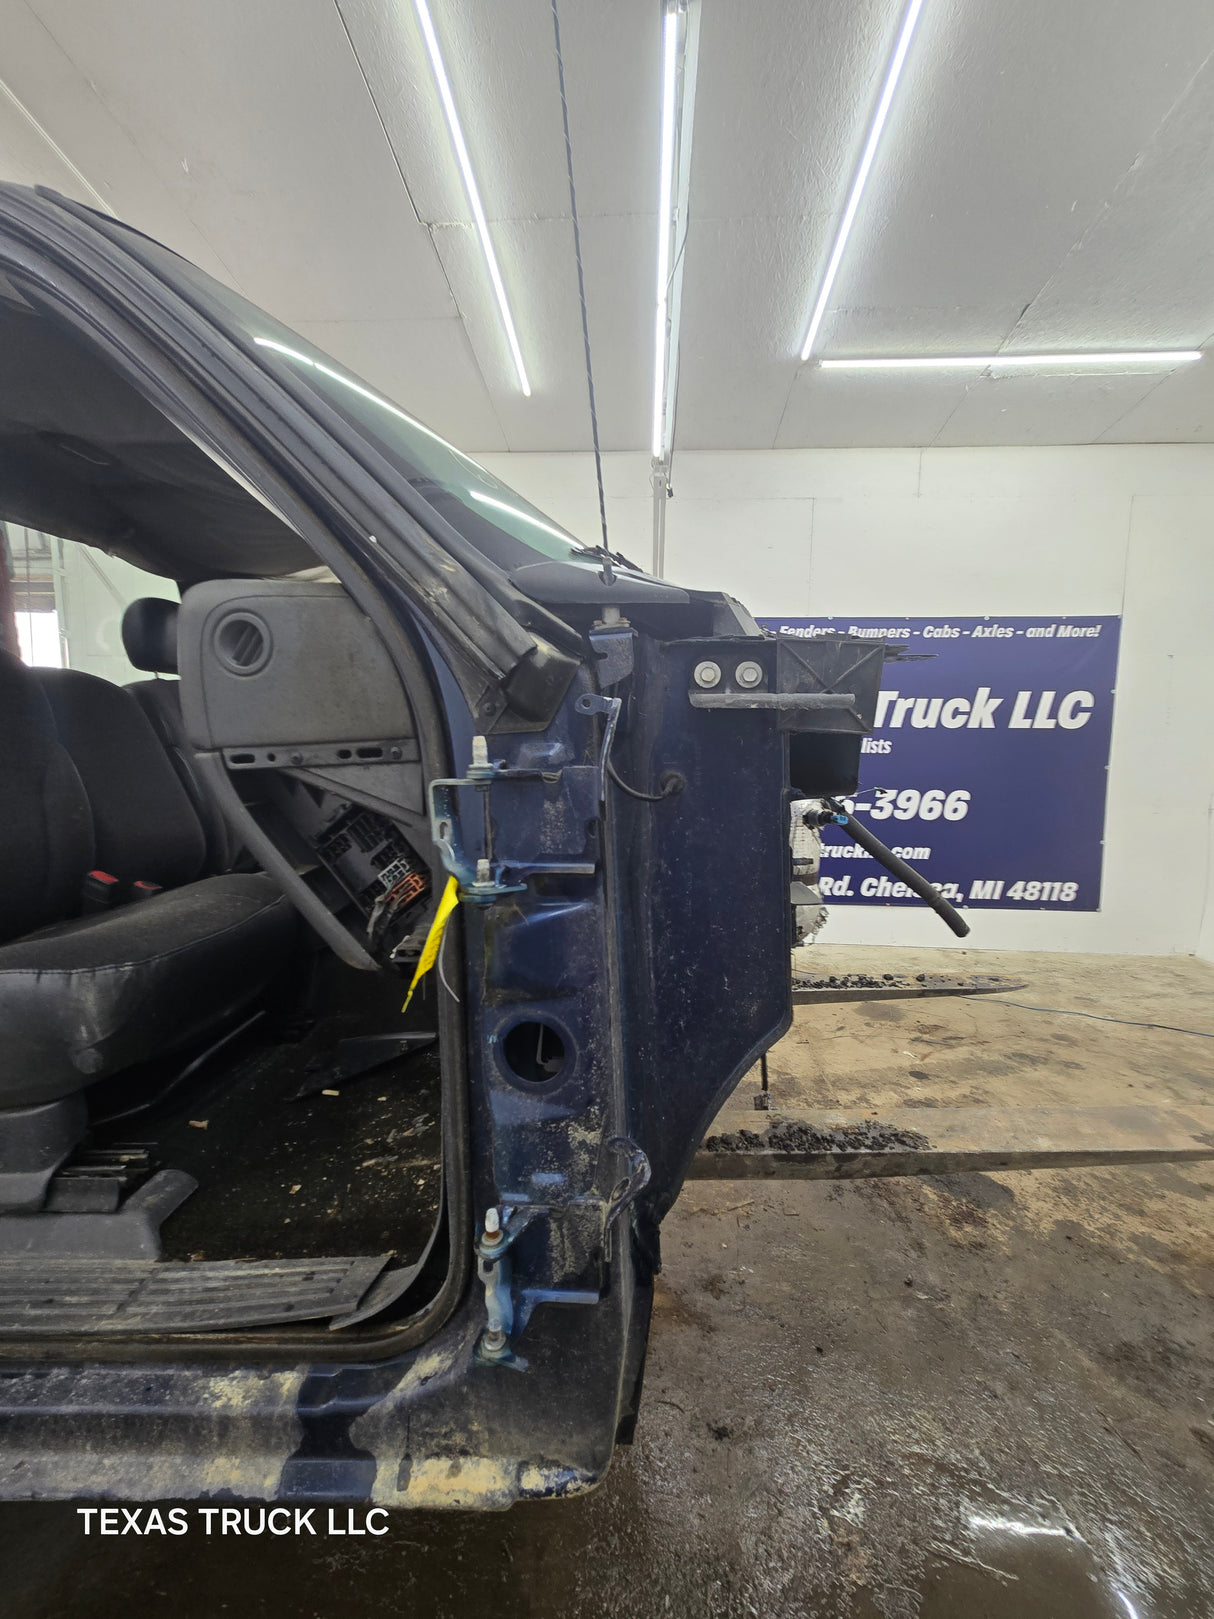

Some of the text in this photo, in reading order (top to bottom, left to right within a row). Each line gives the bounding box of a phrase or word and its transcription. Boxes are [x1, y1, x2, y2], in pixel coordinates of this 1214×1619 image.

[847, 625, 911, 639] Bumpers
[922, 625, 961, 639] Cabs
[971, 624, 1014, 638] Axles
[1026, 624, 1056, 638] and
[1056, 624, 1102, 638] More!
[873, 687, 1095, 730] Truck LLC
[819, 876, 1079, 903] Rd. Cheea, MI 48118
